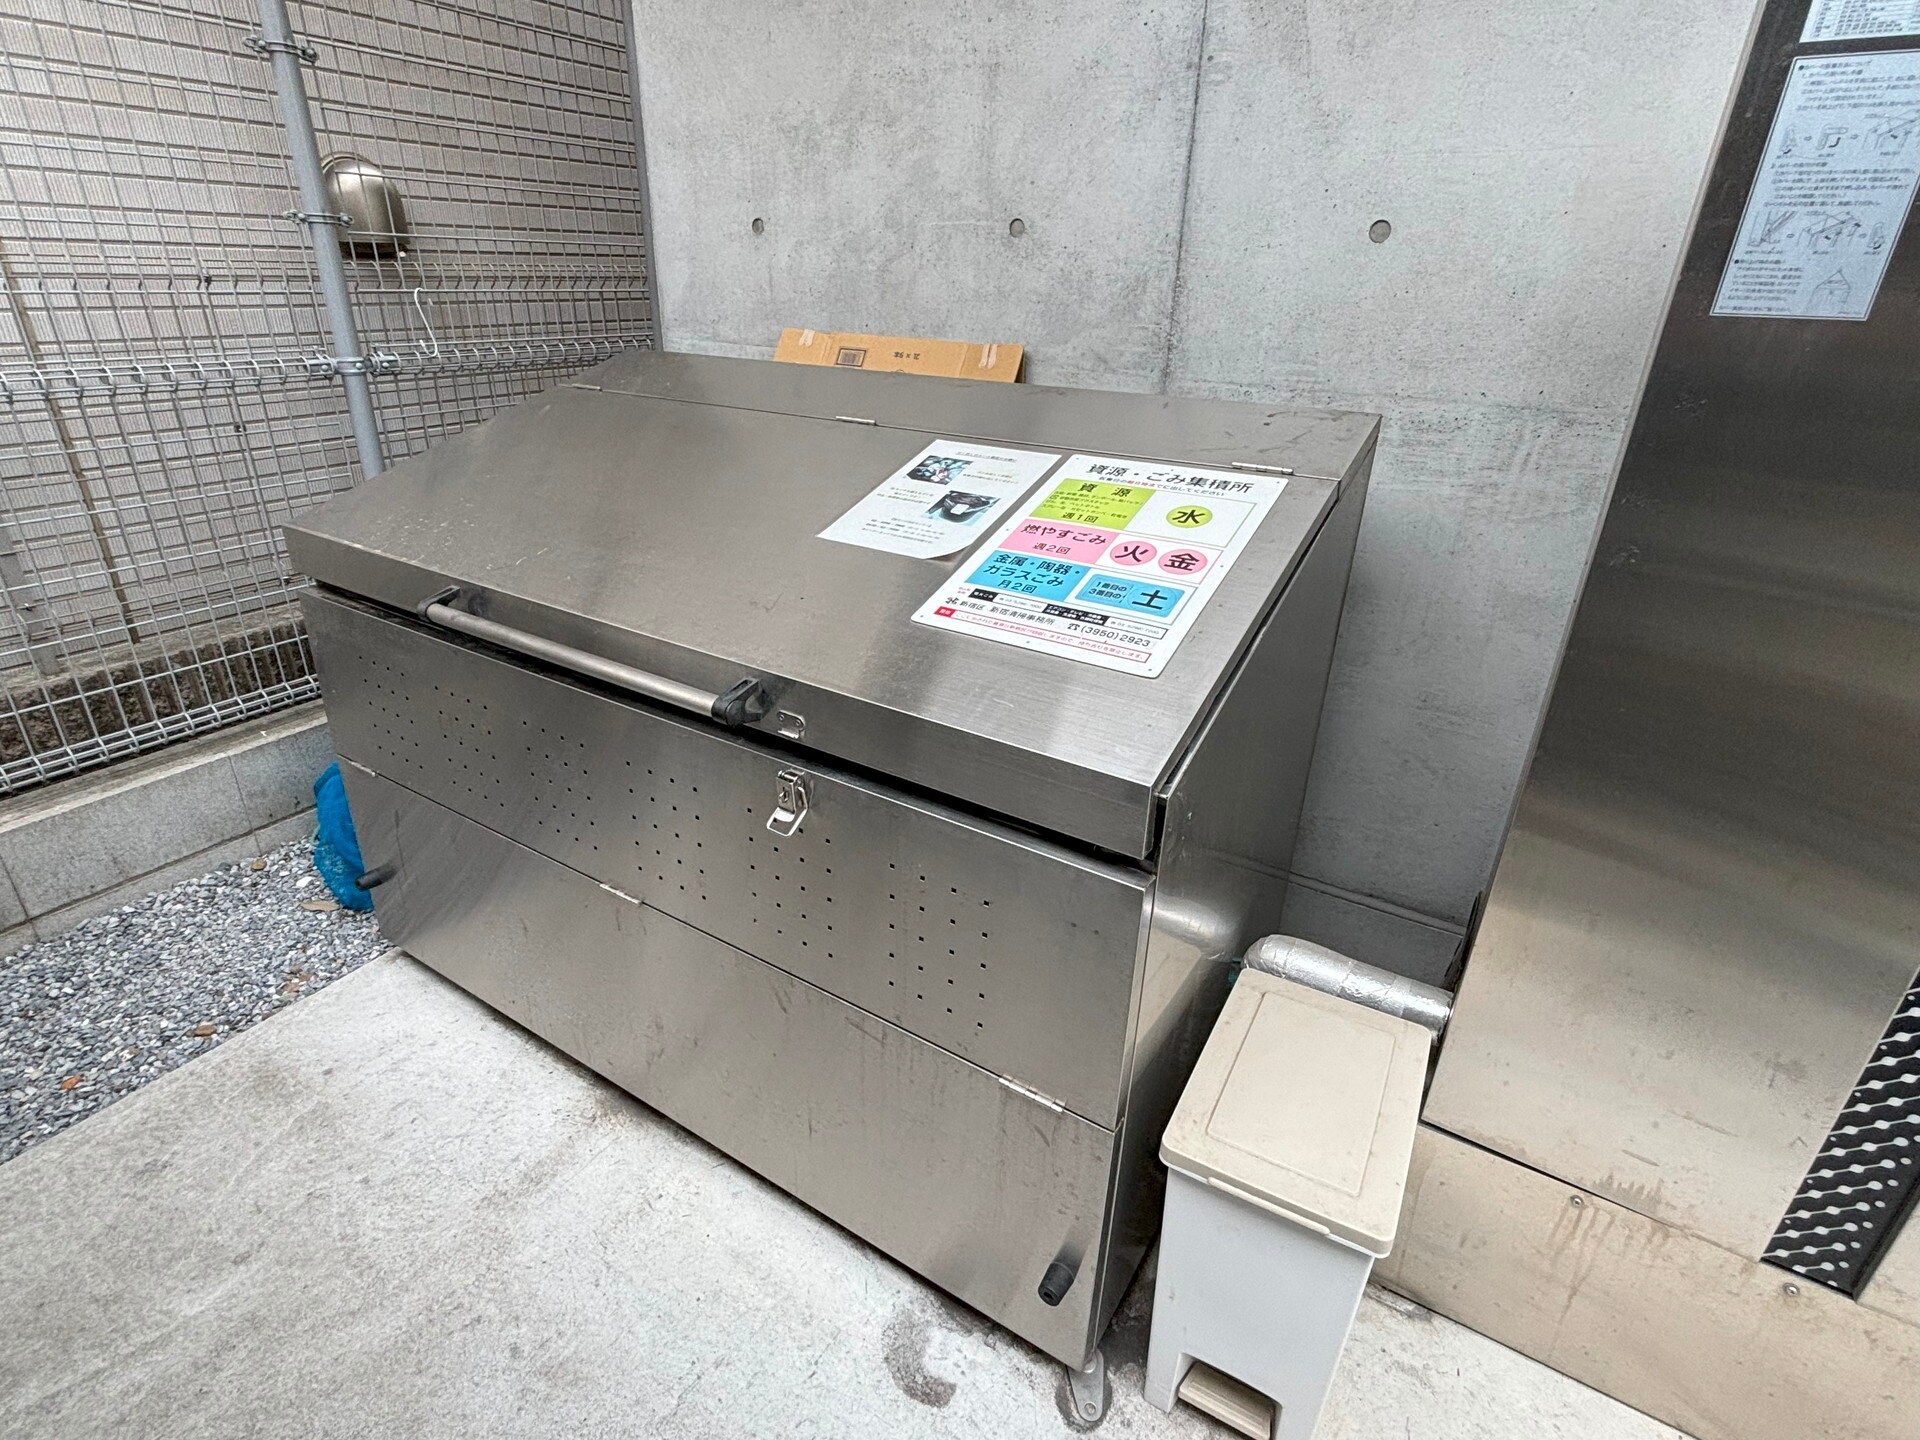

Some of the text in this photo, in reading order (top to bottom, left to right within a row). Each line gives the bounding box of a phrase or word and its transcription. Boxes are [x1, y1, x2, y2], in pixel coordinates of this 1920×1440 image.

[1086, 463, 1255, 494] 資源・ごみ集積所
[1172, 509, 1205, 525] 水
[1021, 524, 1107, 545] 燃やすごみ
[1033, 542, 1071, 555] 週2回
[1115, 545, 1149, 563] 火
[1164, 552, 1200, 572] 金
[984, 565, 1065, 587] ガラスごみ
[998, 579, 1037, 594] 月2回
[1132, 589, 1168, 610] 土
